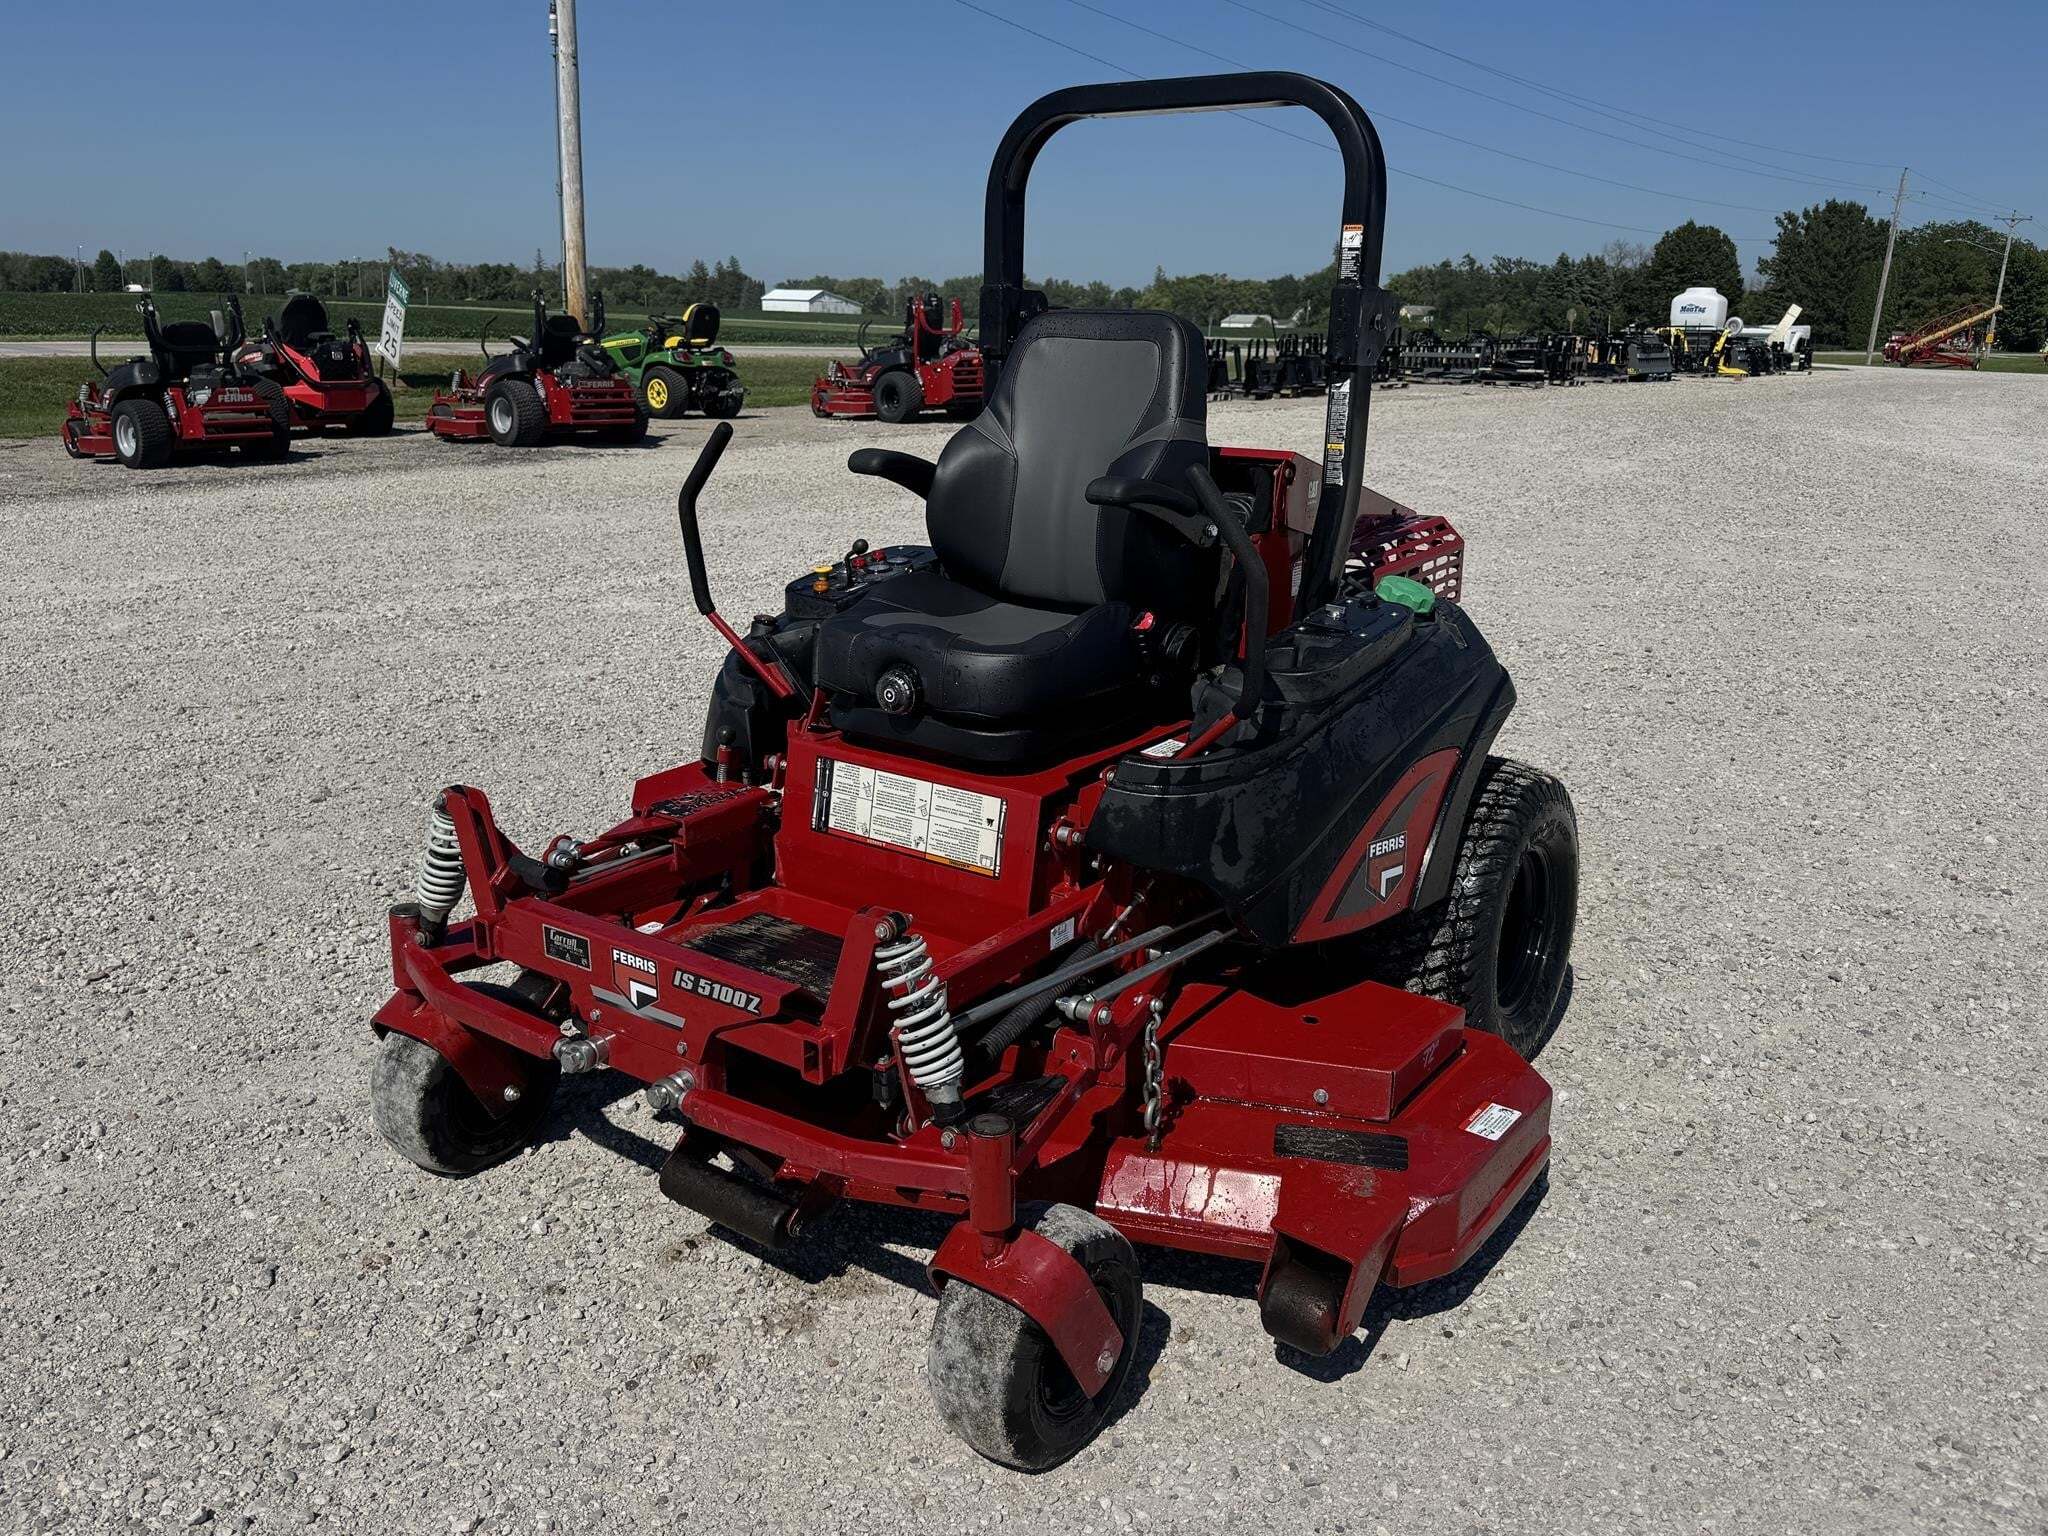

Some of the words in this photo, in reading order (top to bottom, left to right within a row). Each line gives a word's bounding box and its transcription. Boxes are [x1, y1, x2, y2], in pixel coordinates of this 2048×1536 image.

[388, 299, 402, 321] SPEED
[387, 315, 399, 334] LIMIT
[385, 331, 397, 359] 25
[218, 394, 253, 403] FERRIS
[1370, 835, 1405, 858] FERRIS
[612, 949, 656, 974] FERRIS
[673, 970, 694, 990] IS
[697, 980, 761, 1016] 5100Z
